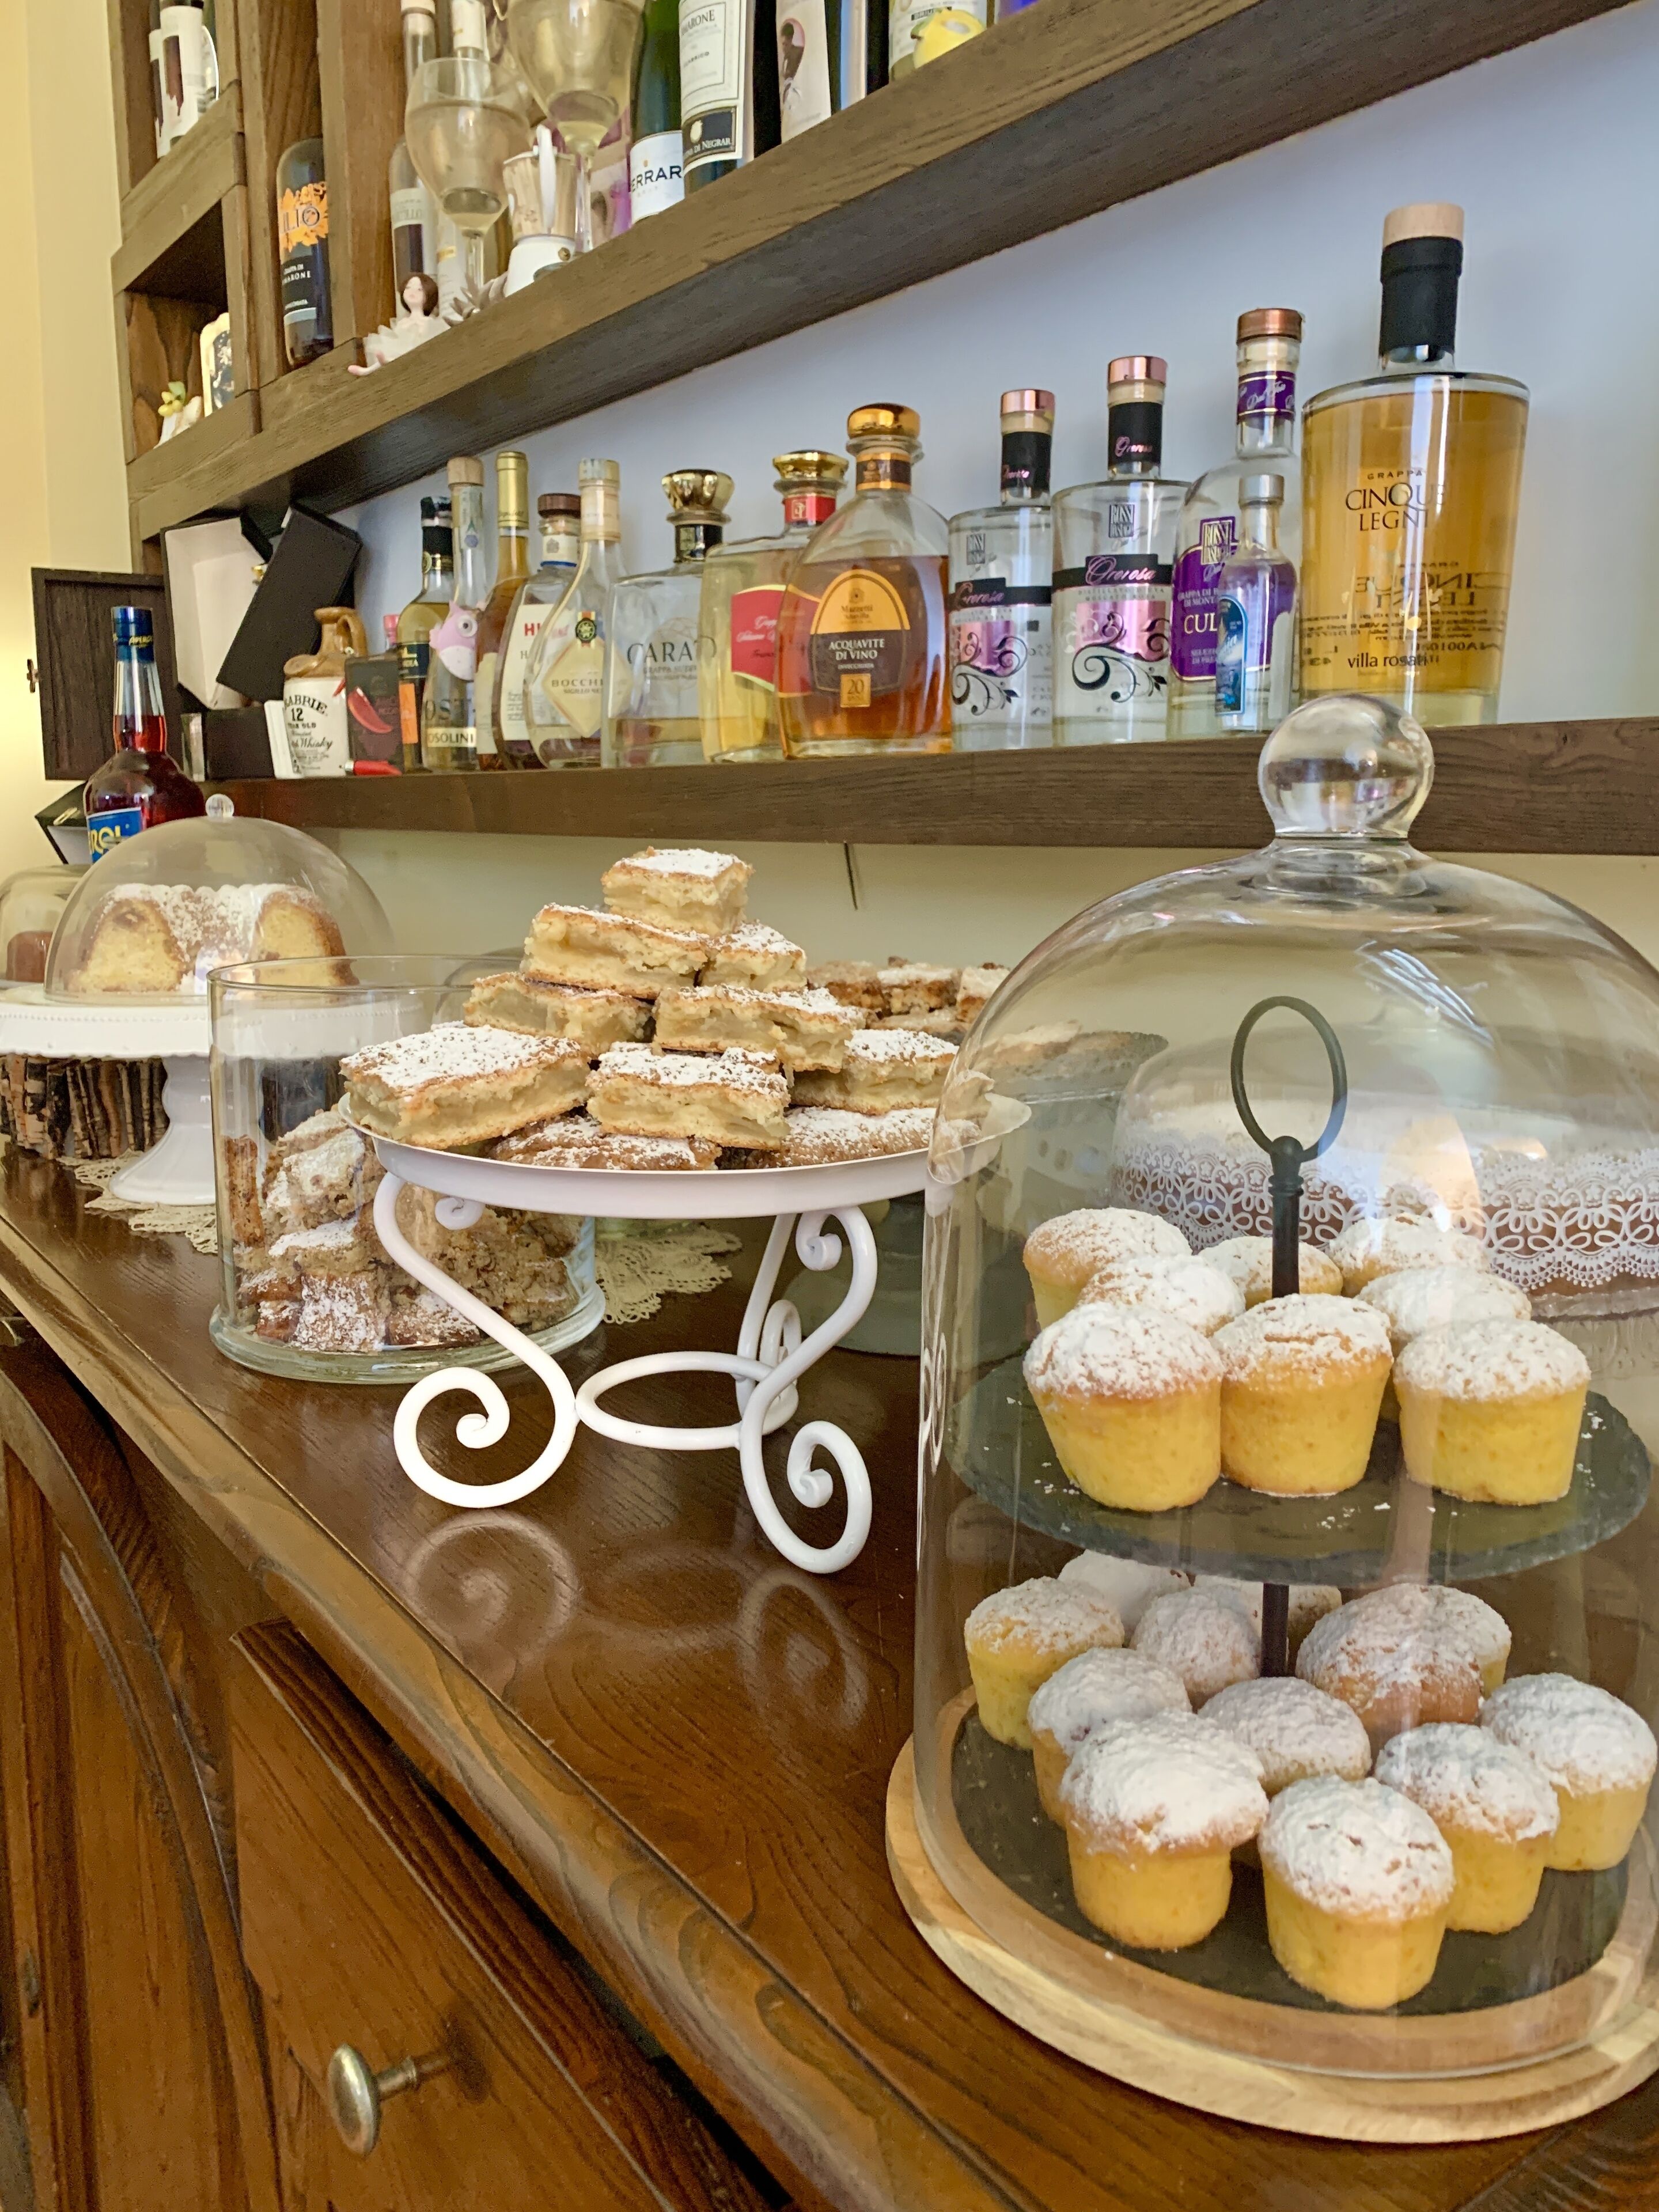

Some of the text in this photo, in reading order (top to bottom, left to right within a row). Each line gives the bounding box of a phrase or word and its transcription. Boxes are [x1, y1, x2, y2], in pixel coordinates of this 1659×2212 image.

[1367, 469, 1423, 480] GRAPPA
[1346, 483, 1445, 511] CINQUE
[1359, 510, 1429, 531] LEGNI
[828, 639, 885, 651] ACQUAVITE
[836, 650, 878, 660] DI VINO
[1348, 653, 1378, 668] villa
[847, 679, 865, 695] 20
[291, 707, 304, 721] 12
[300, 737, 332, 751] Whisky
